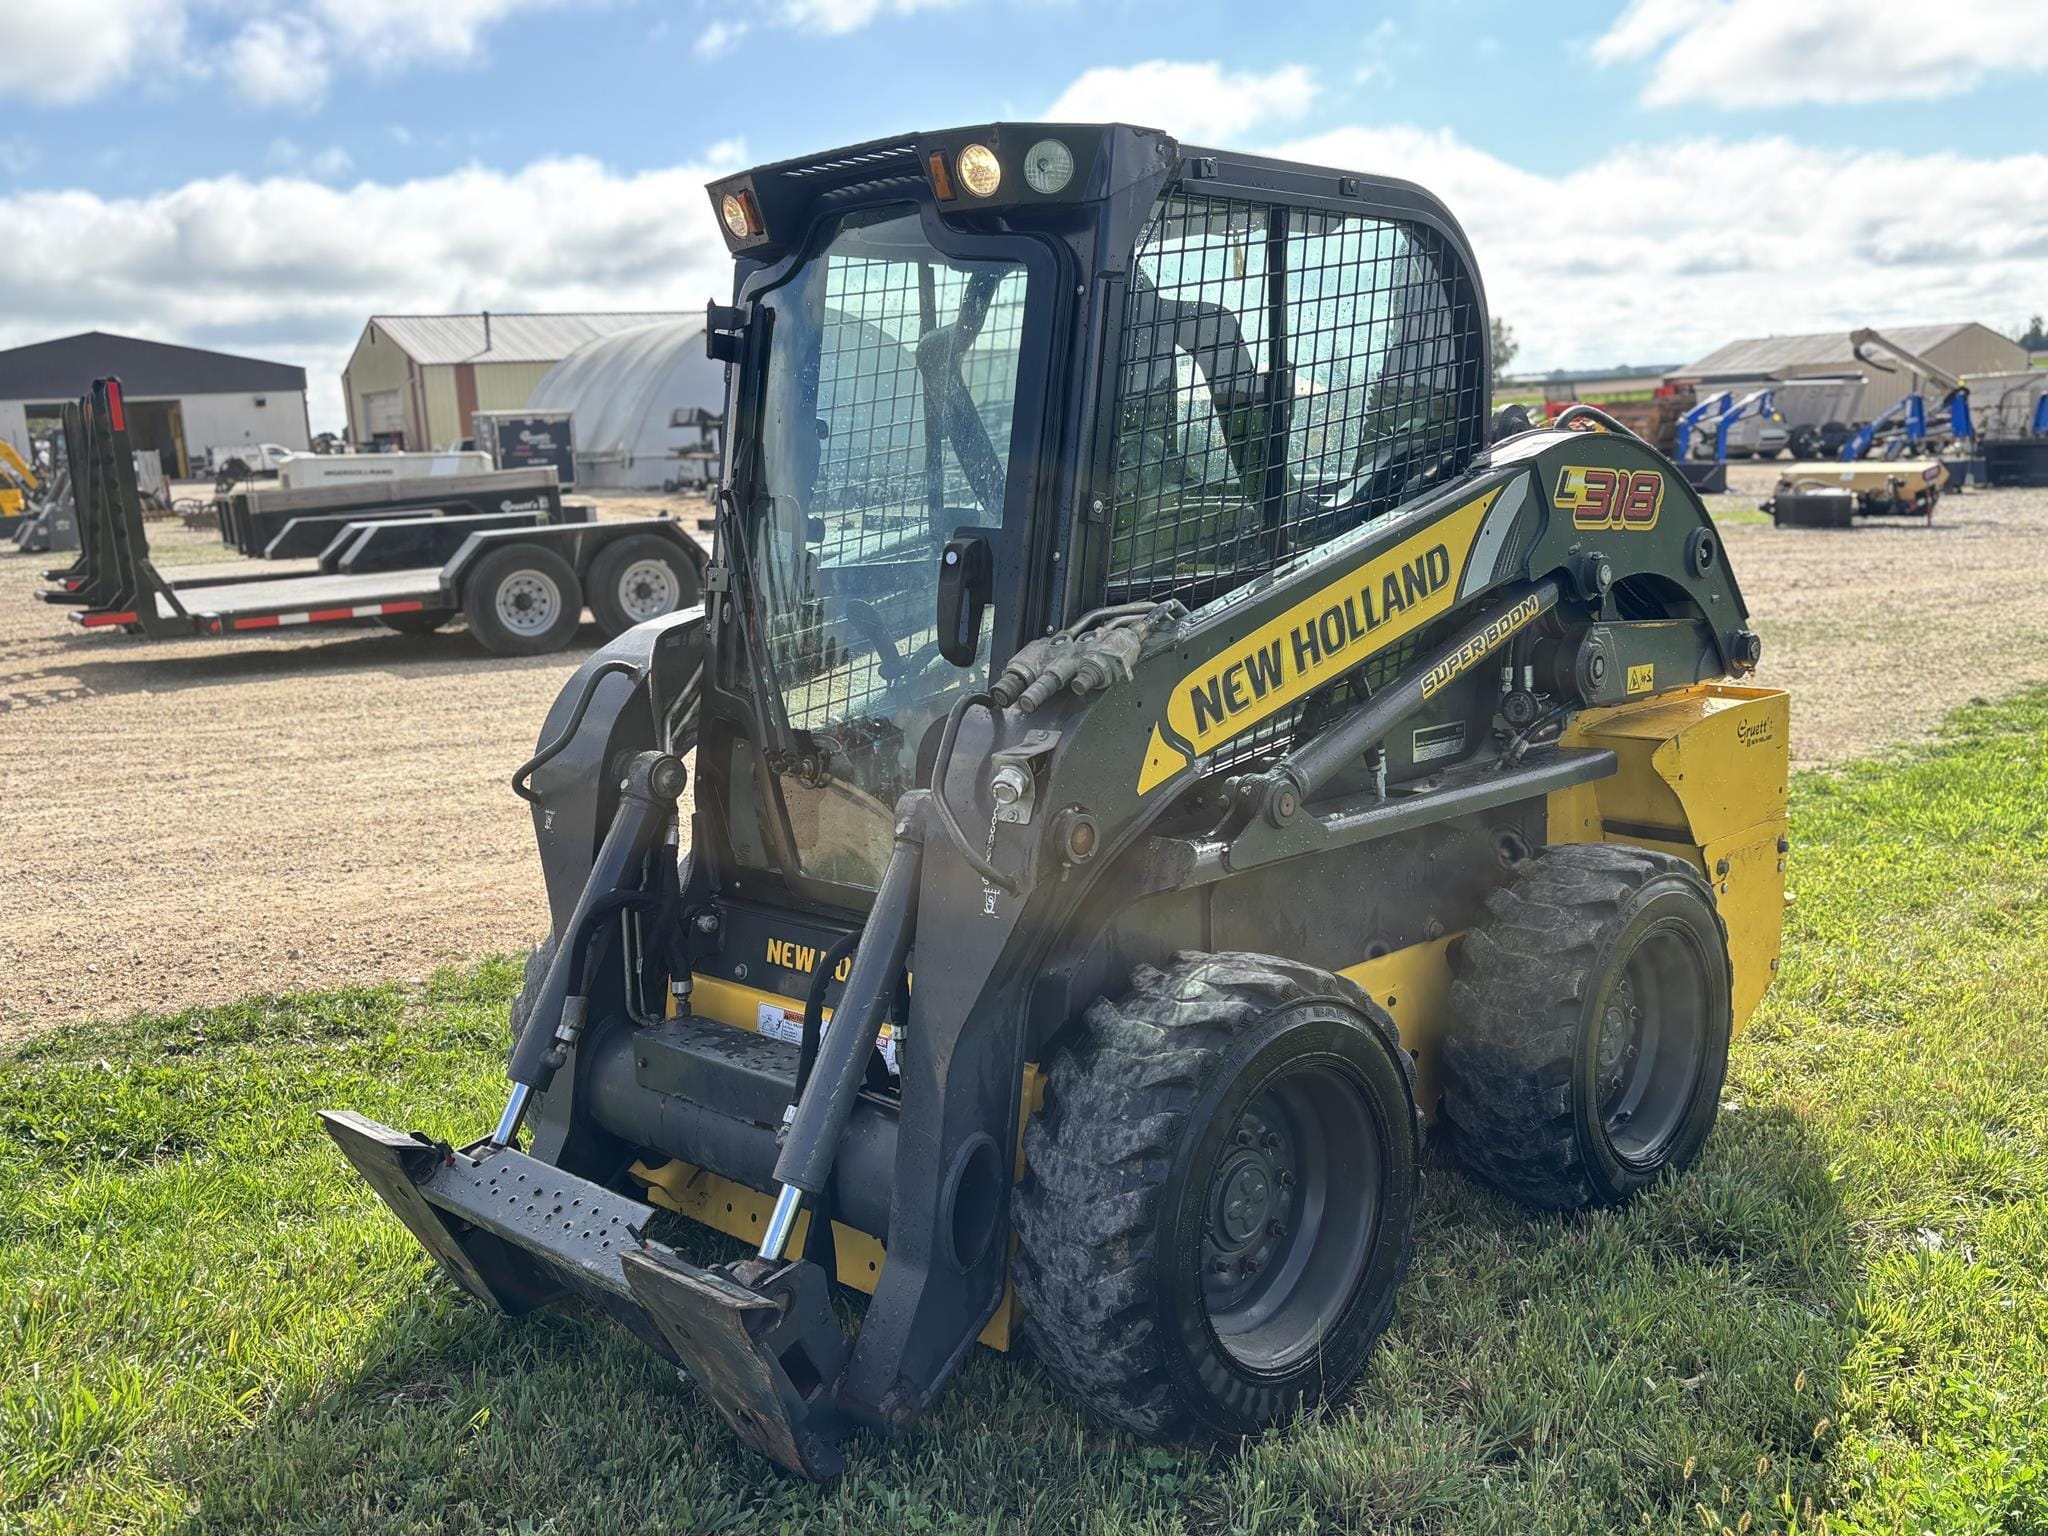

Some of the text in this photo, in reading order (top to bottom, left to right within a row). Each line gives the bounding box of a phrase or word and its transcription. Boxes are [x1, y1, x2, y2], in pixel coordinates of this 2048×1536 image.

[1189, 543, 1451, 736] NEW HOLLAND
[1421, 594, 1539, 699] SUPER BOOM
[766, 938, 816, 973] NEW
